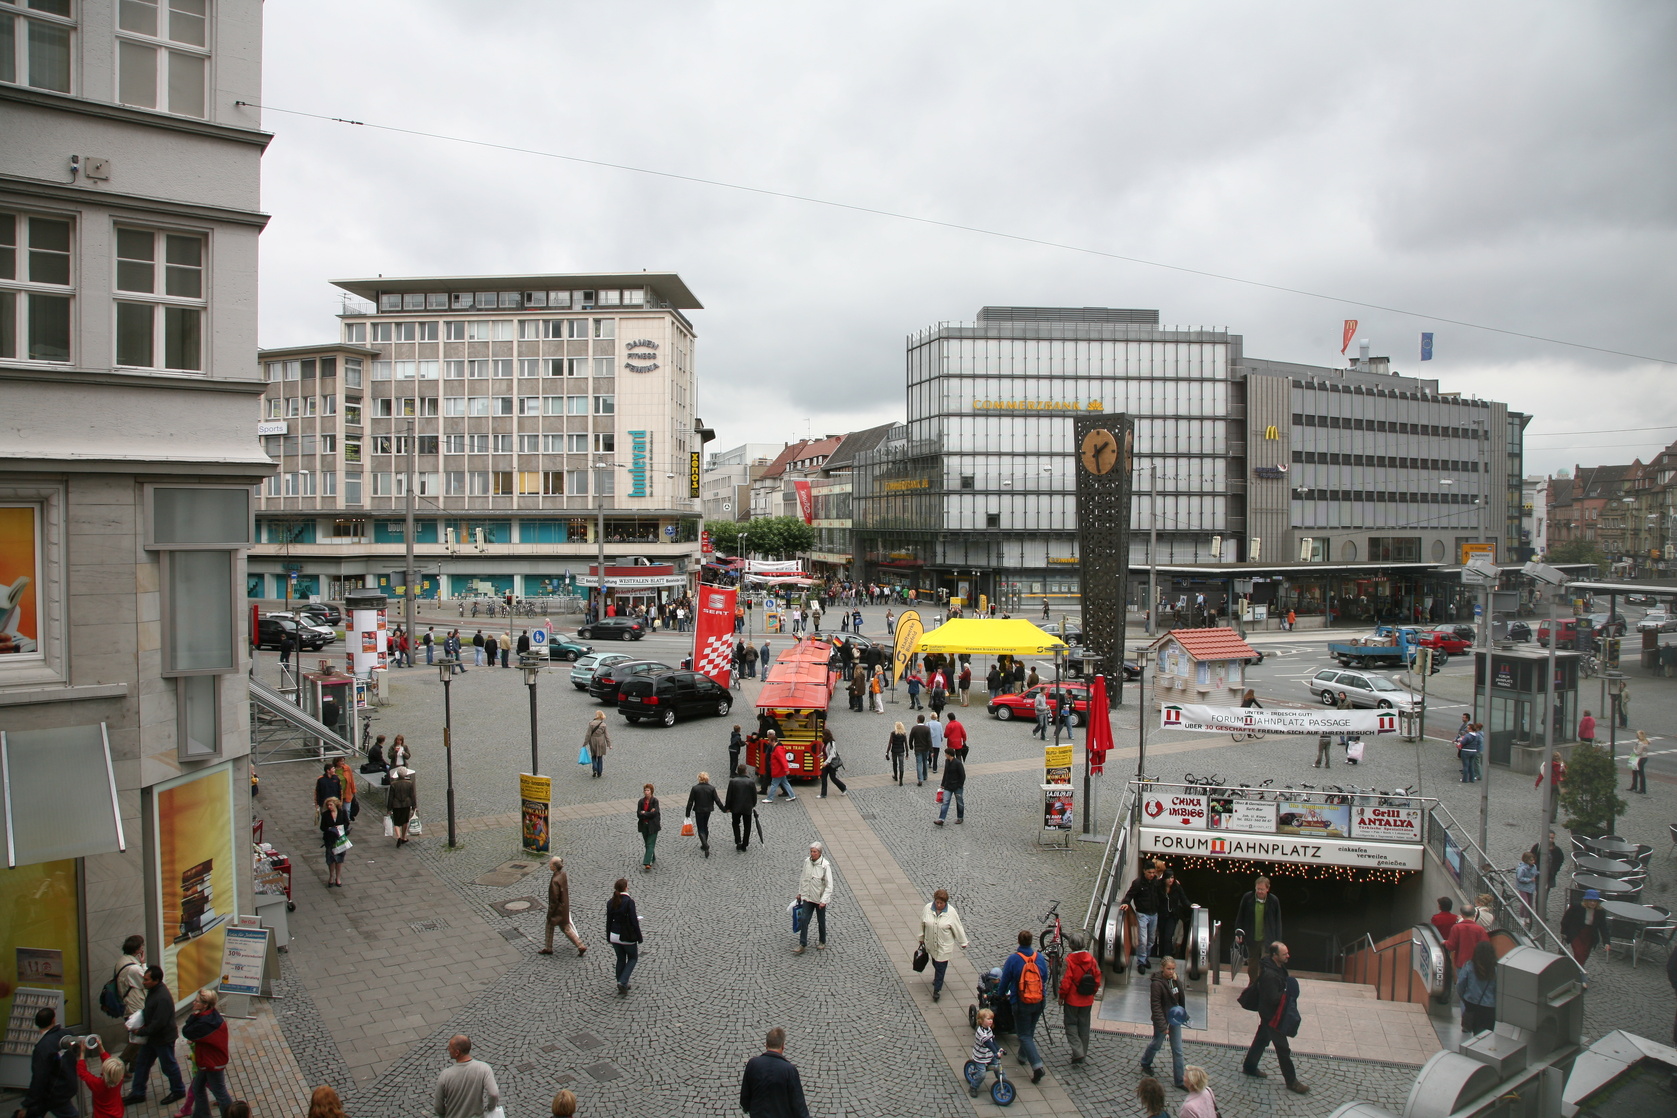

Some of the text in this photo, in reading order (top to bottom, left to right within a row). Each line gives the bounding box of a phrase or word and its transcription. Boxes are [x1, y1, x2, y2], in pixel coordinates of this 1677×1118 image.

[625, 339, 660, 351] DAMEN
[627, 352, 657, 360] FITNESS
[624, 362, 660, 374] FEMINA
[972, 399, 1081, 410] COMMERZBANK
[258, 425, 284, 433] Sports
[627, 430, 647, 498] boulevard
[900, 622, 915, 650] Stadtwerke
[905, 631, 918, 653] Bielefeld
[319, 660, 327, 671] T
[1211, 715, 1351, 727] FORUM JAHNPLATZ PASSAGE
[1215, 725, 1256, 733] GESCHÄFTE
[1171, 796, 1202, 807] CHINA
[1168, 807, 1205, 818] IMBISS
[1372, 809, 1400, 818] Grill
[1358, 817, 1414, 828] ANTALYA
[1154, 835, 1322, 858] FORUM JAHNPLATZ
